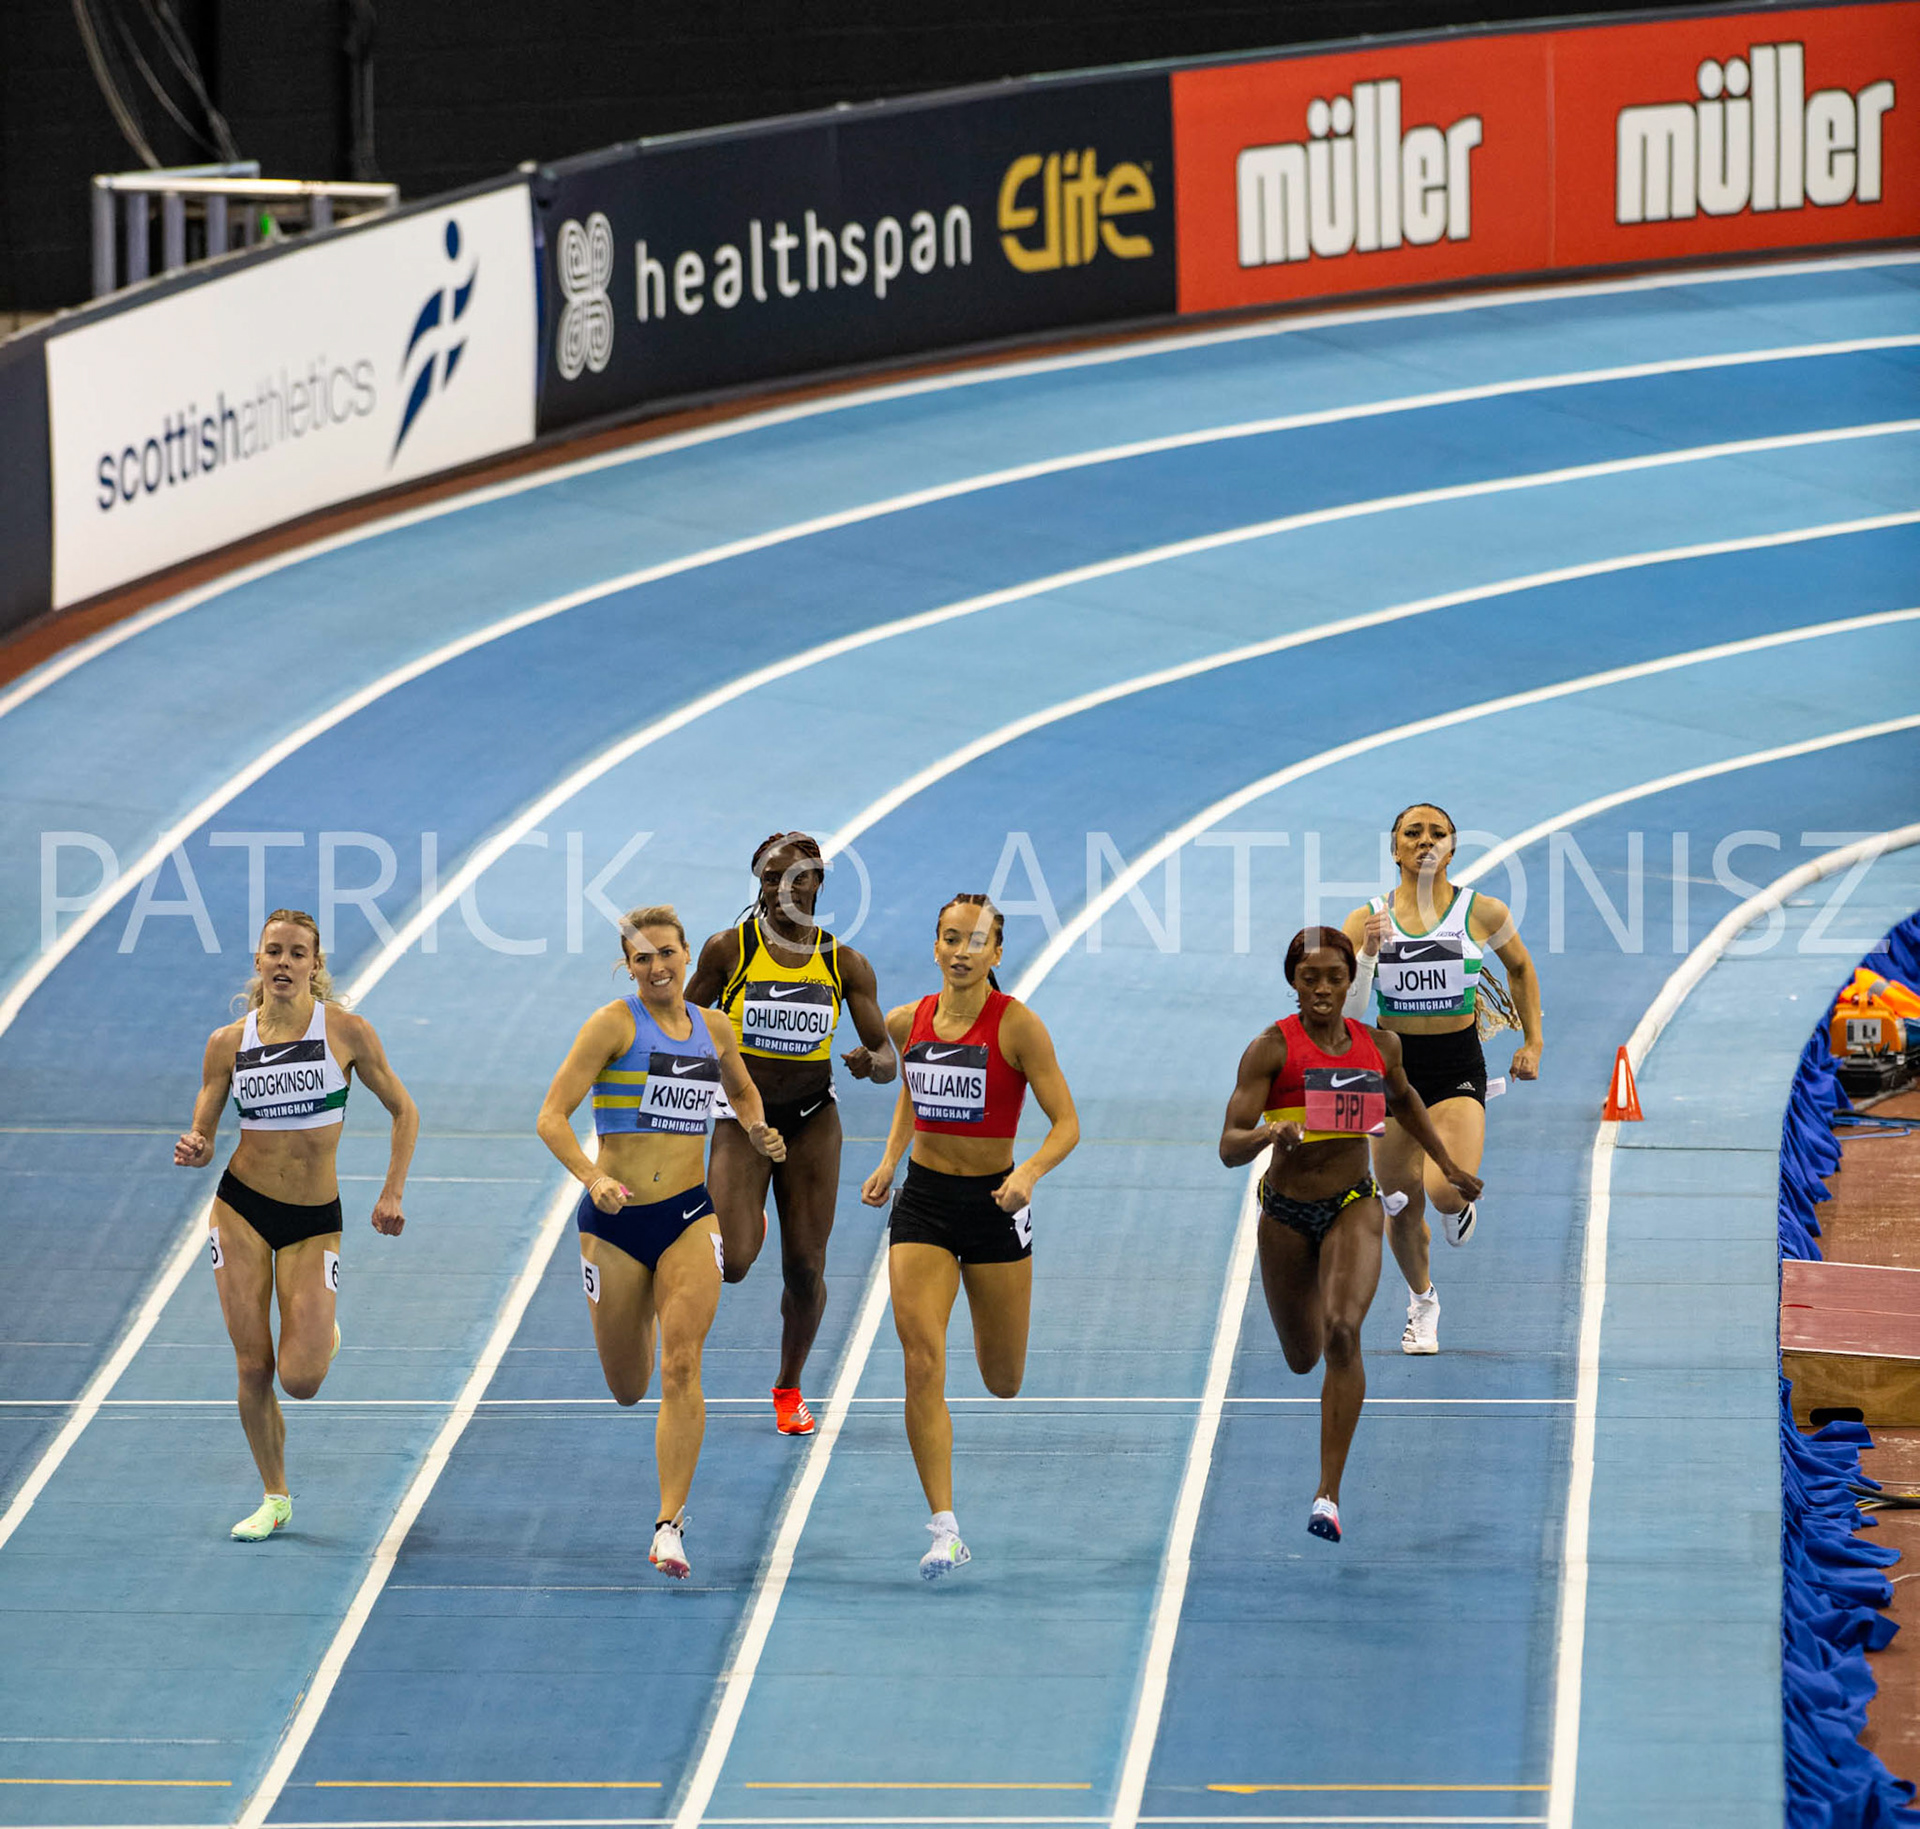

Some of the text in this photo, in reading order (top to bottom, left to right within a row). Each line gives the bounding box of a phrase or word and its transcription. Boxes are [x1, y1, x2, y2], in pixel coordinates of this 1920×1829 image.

[1616, 42, 1896, 224] müller
[1237, 78, 1482, 268] müller
[635, 147, 1156, 322] healthspan Elite
[97, 357, 376, 513] scottishathletics
[1394, 968, 1447, 992] JOHN
[746, 1007, 830, 1035] OHURUOGU
[1393, 999, 1453, 1011] BIRMINGHAM
[240, 1068, 324, 1100] HODGKINSON
[907, 1070, 982, 1099] WILLIAMS
[1334, 1093, 1365, 1130] PIPI
[584, 1265, 595, 1294] 5
